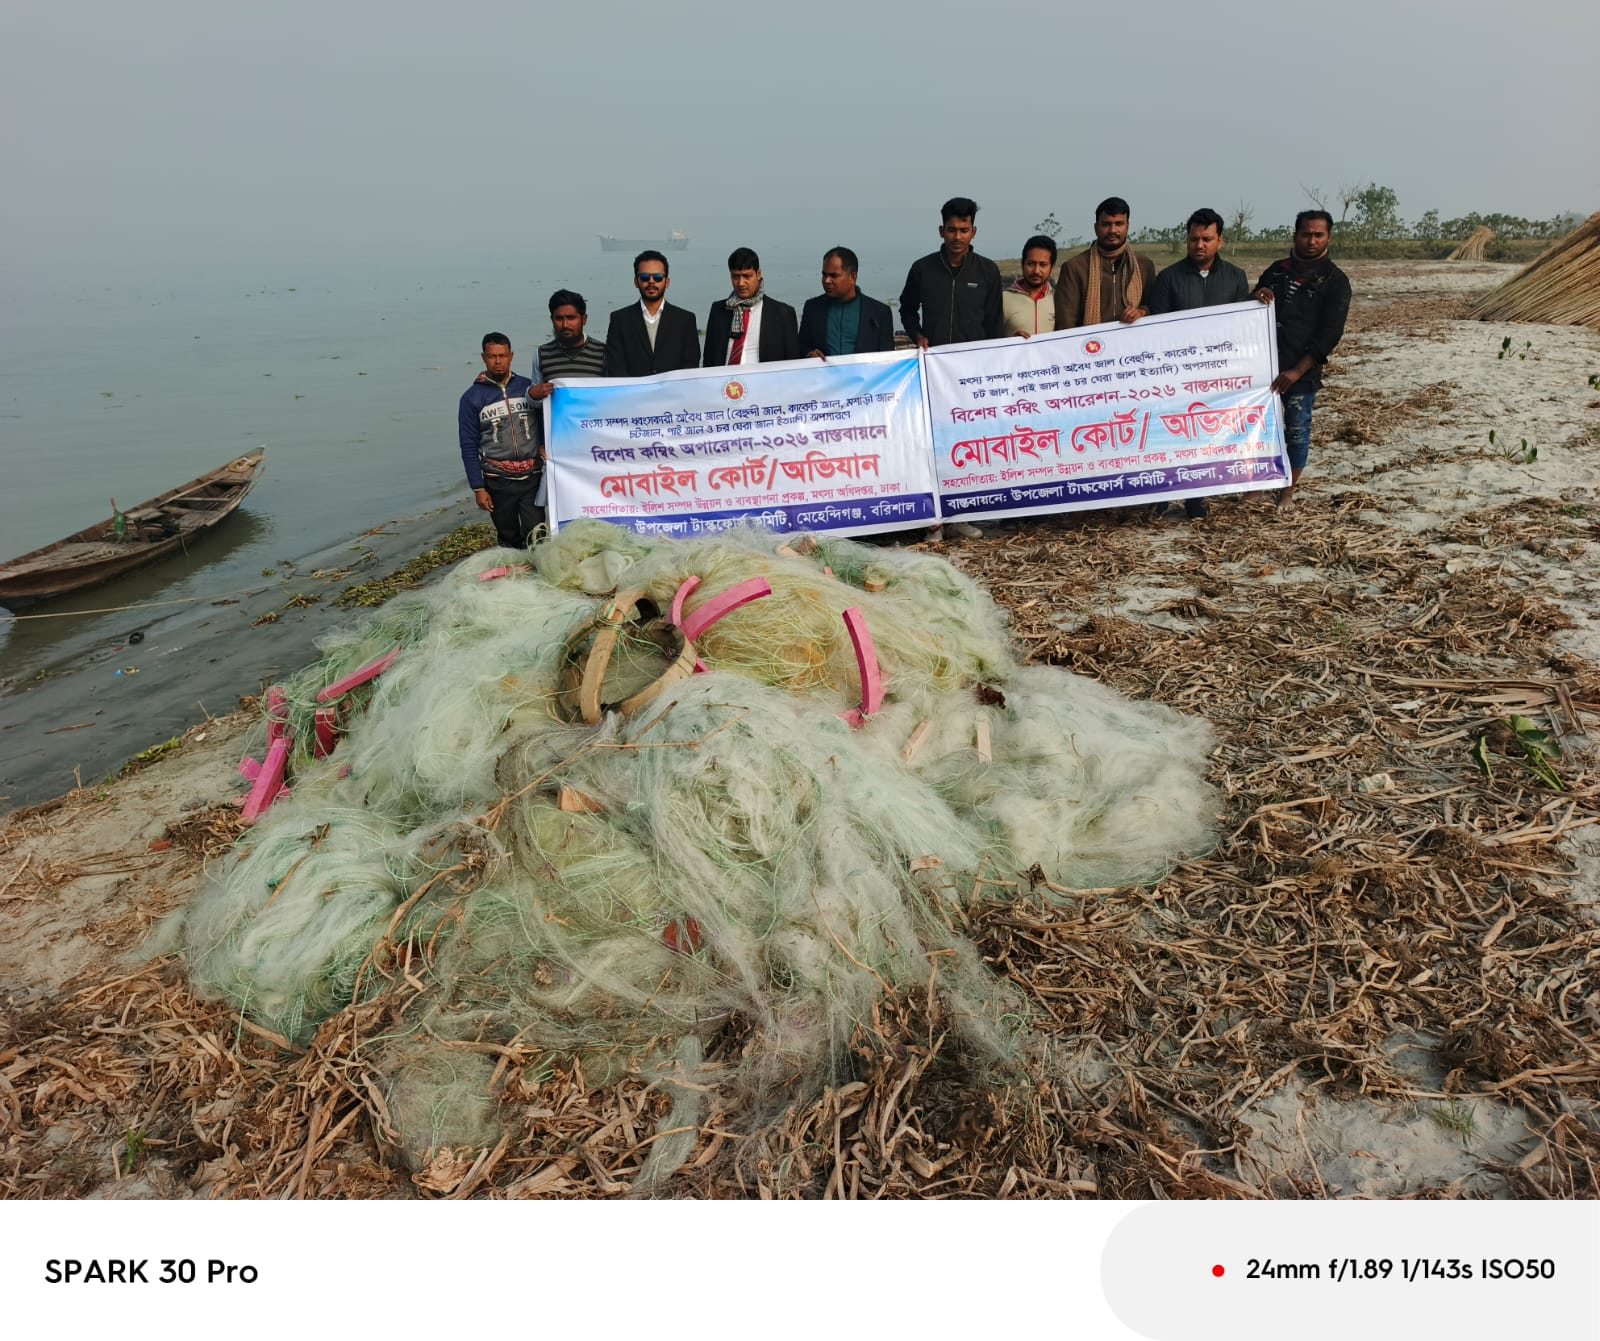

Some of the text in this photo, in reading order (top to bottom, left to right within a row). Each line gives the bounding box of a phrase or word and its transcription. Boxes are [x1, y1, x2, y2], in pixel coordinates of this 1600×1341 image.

[972, 389, 986, 399] চট
[1017, 382, 1036, 395] পাই
[1039, 380, 1059, 391] জাল
[1073, 377, 1087, 387] চর
[1091, 373, 1112, 384] ঘেরা
[1115, 371, 1136, 381] জাল
[1182, 359, 1228, 371] অপসারণে
[986, 372, 1013, 383] সম্পদ
[1064, 362, 1091, 373] অবৈধ
[1094, 359, 1115, 369] জাল
[675, 409, 702, 424] অবৈধ
[704, 410, 724, 421] জাল
[951, 375, 1253, 425] বিশেষ কম্বিং অপারেশন-২০২৬ বাস্তবায়নে
[591, 424, 888, 463] বিশেষ কম্বিং অপারেশন-২০২৬ বাস্তবায়নে
[685, 425, 704, 436] জাল
[706, 424, 714, 433] ও
[755, 419, 774, 430] জাল
[951, 401, 1266, 468] মোবাইল কোর্ট/ অভিযান
[600, 450, 880, 499] মোবাইল কোর্ট/অভিযান
[947, 493, 1007, 511] বাস্তবায়নে:
[1011, 485, 1064, 502] উপজেলা
[1226, 461, 1270, 478] বরিশাল
[1000, 468, 1024, 481] ইলিশ
[1027, 466, 1054, 477] সম্পদ
[1087, 461, 1095, 470] ও
[641, 499, 665, 513] ইলিশ
[725, 498, 733, 507] ও
[880, 482, 901, 494] ঢাকা
[634, 519, 688, 534] উপজেলা
[797, 505, 866, 524] মেহেন্দিগঞ্জ,
[871, 500, 915, 516] বরিশাল
